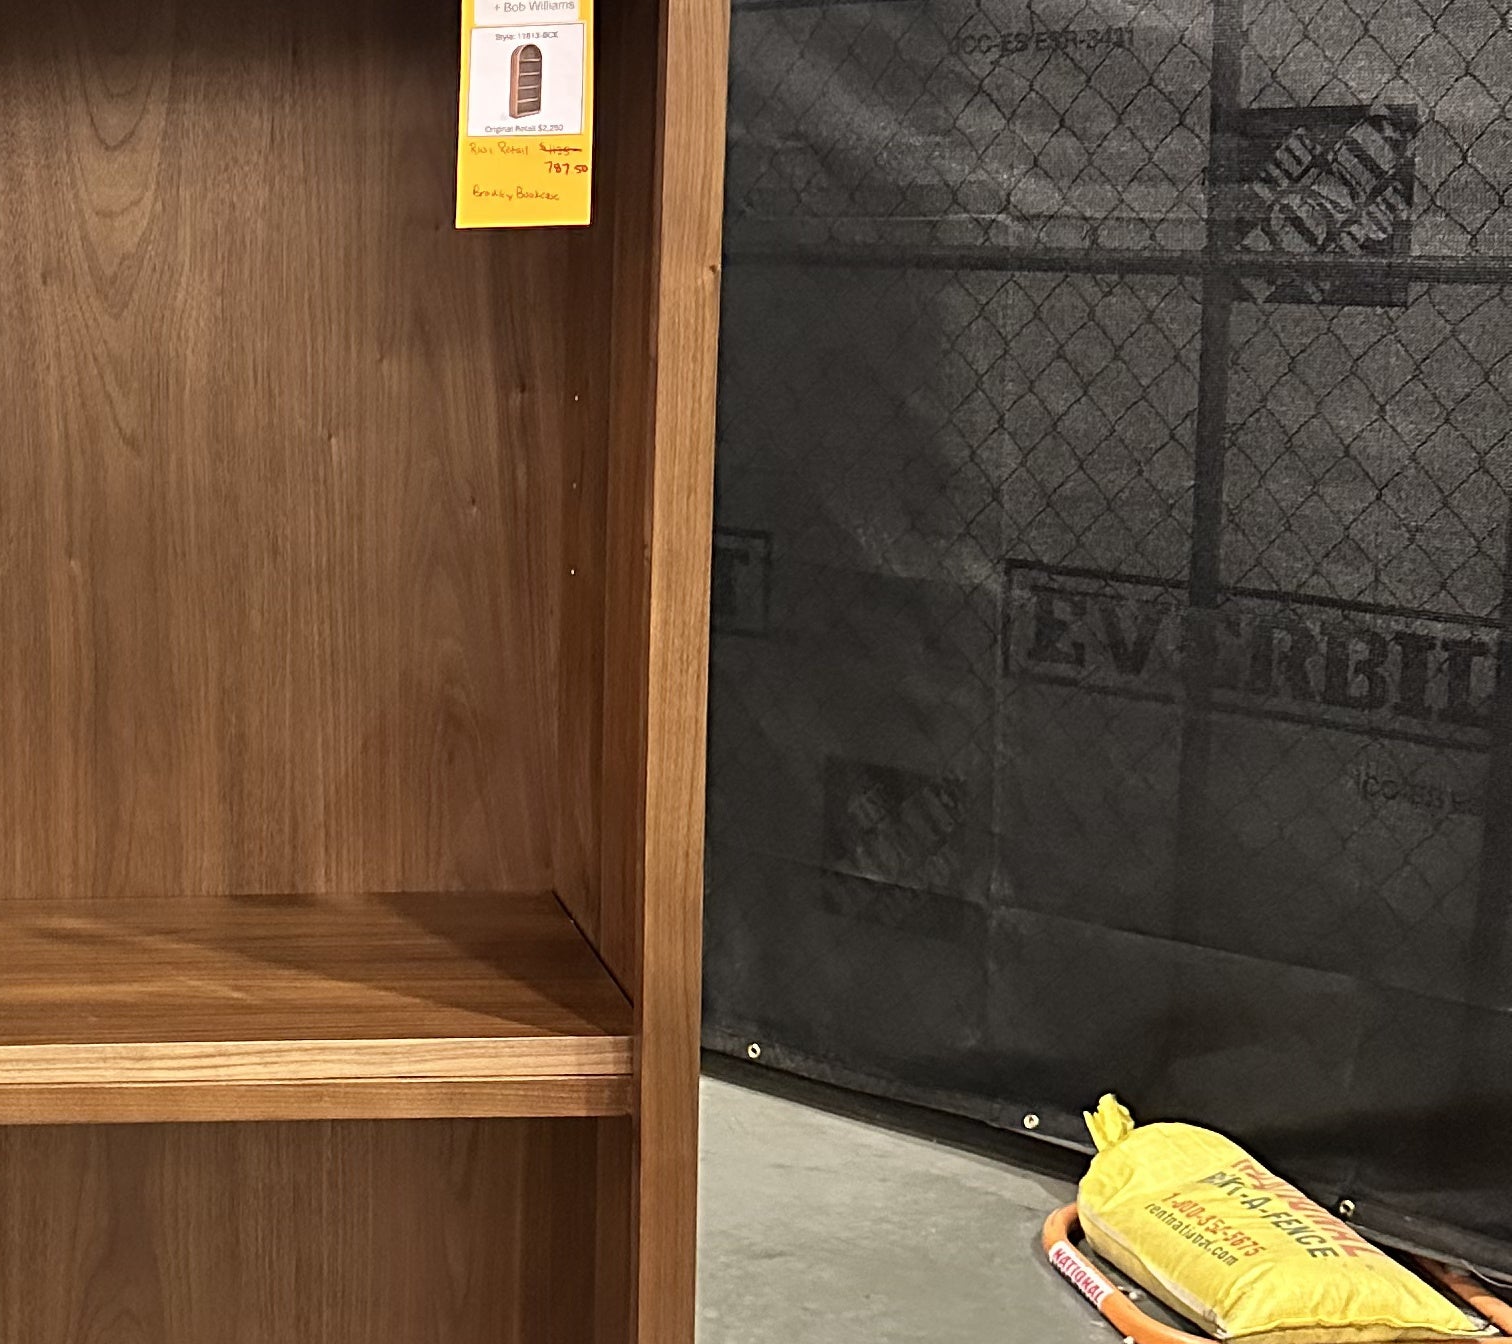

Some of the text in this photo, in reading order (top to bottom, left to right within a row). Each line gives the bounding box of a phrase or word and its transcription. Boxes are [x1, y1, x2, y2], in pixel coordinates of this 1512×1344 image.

[504, 2, 525, 12] Bob
[529, 1, 575, 10] Williams
[1053, 1248, 1104, 1303] NATIONAL
